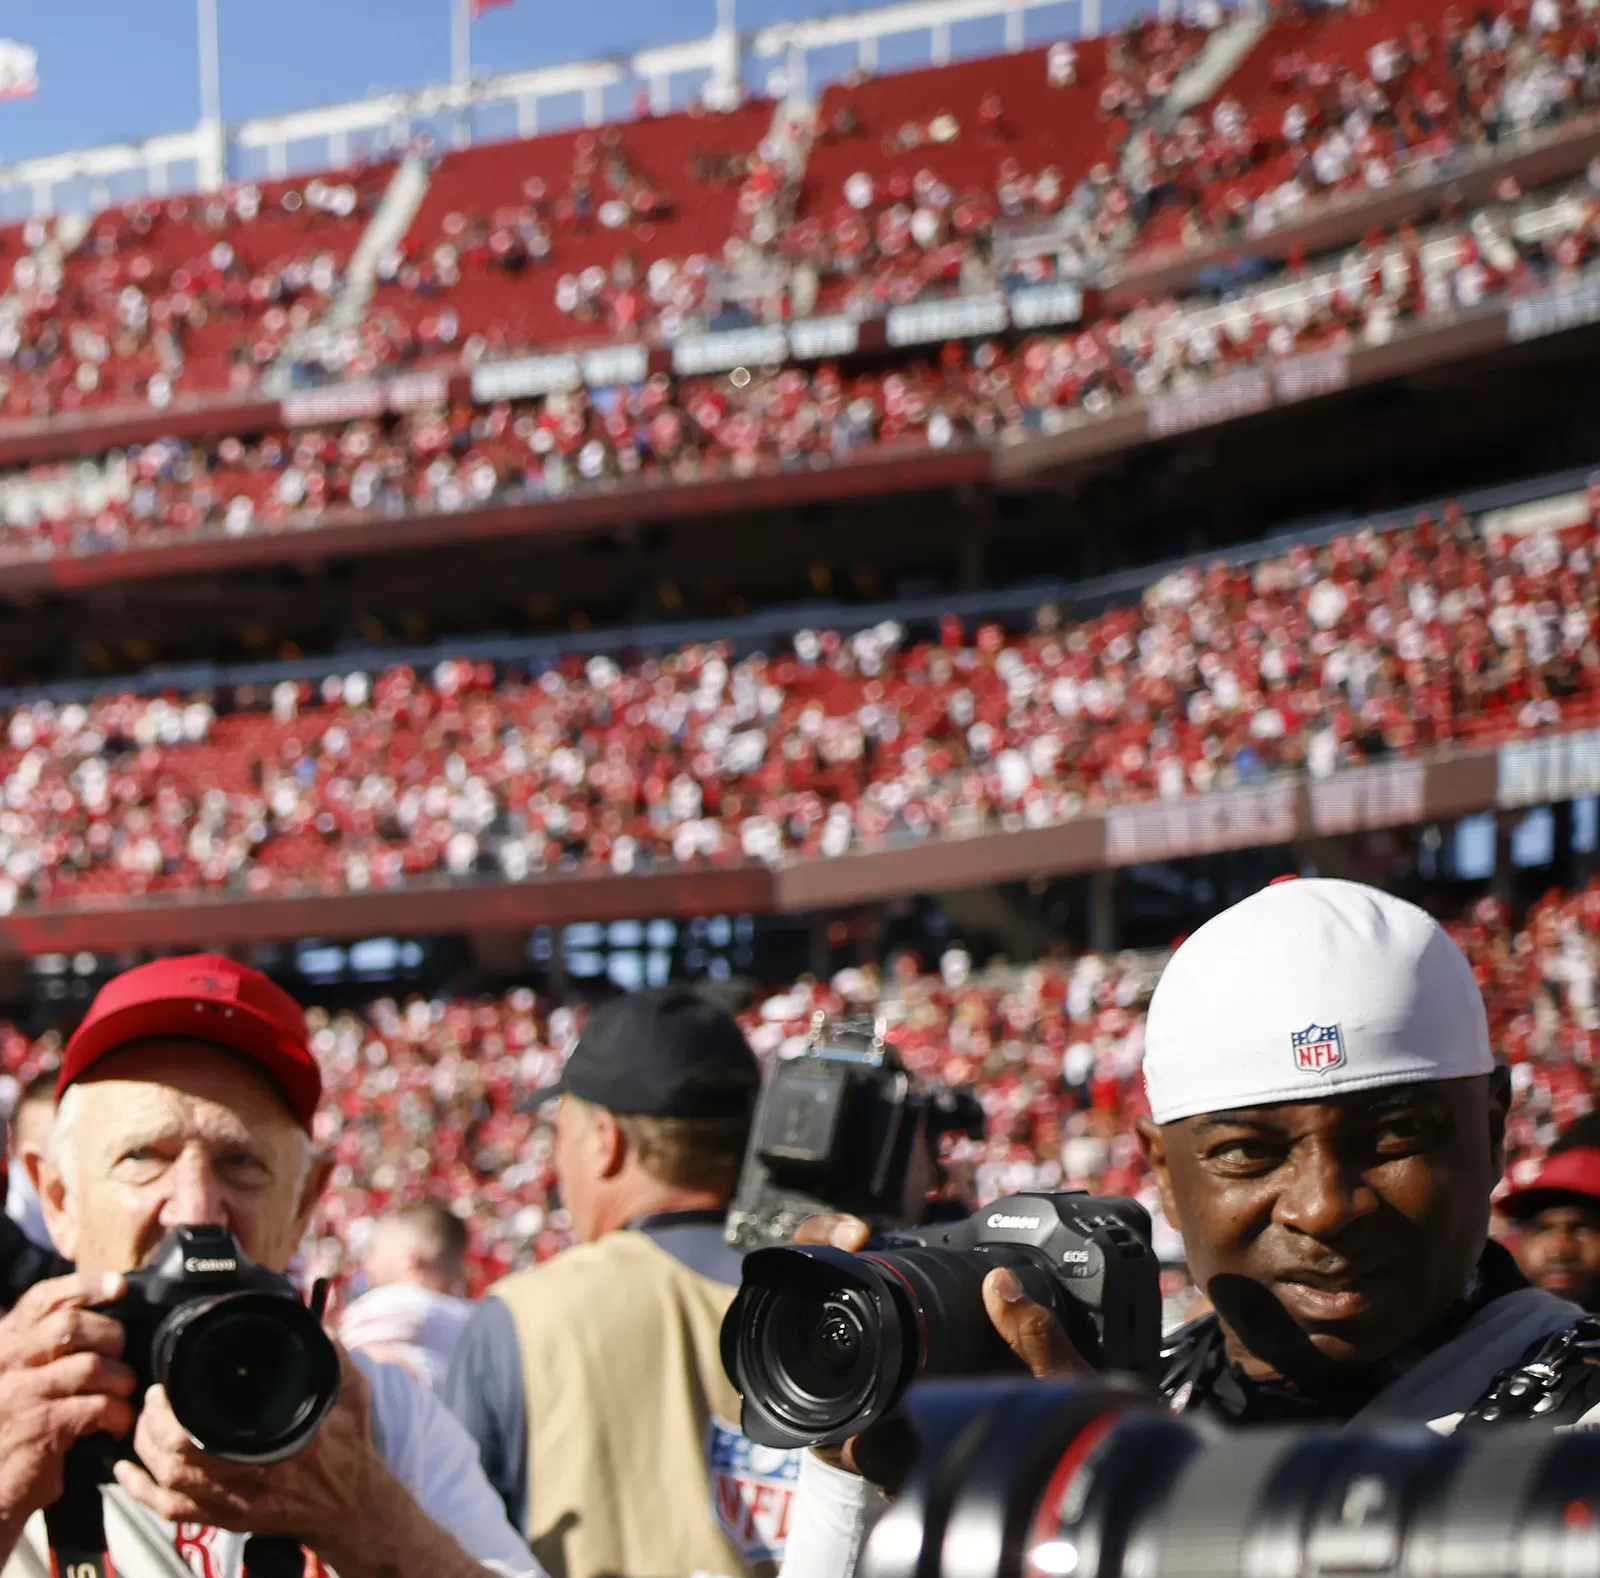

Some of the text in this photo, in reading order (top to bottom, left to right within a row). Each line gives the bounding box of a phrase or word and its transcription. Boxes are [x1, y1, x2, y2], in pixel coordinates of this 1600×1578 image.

[1298, 1043, 1340, 1068] NFL
[986, 1212, 1041, 1230] Canon
[184, 1256, 237, 1273] Canon
[1062, 1250, 1090, 1263] EOS
